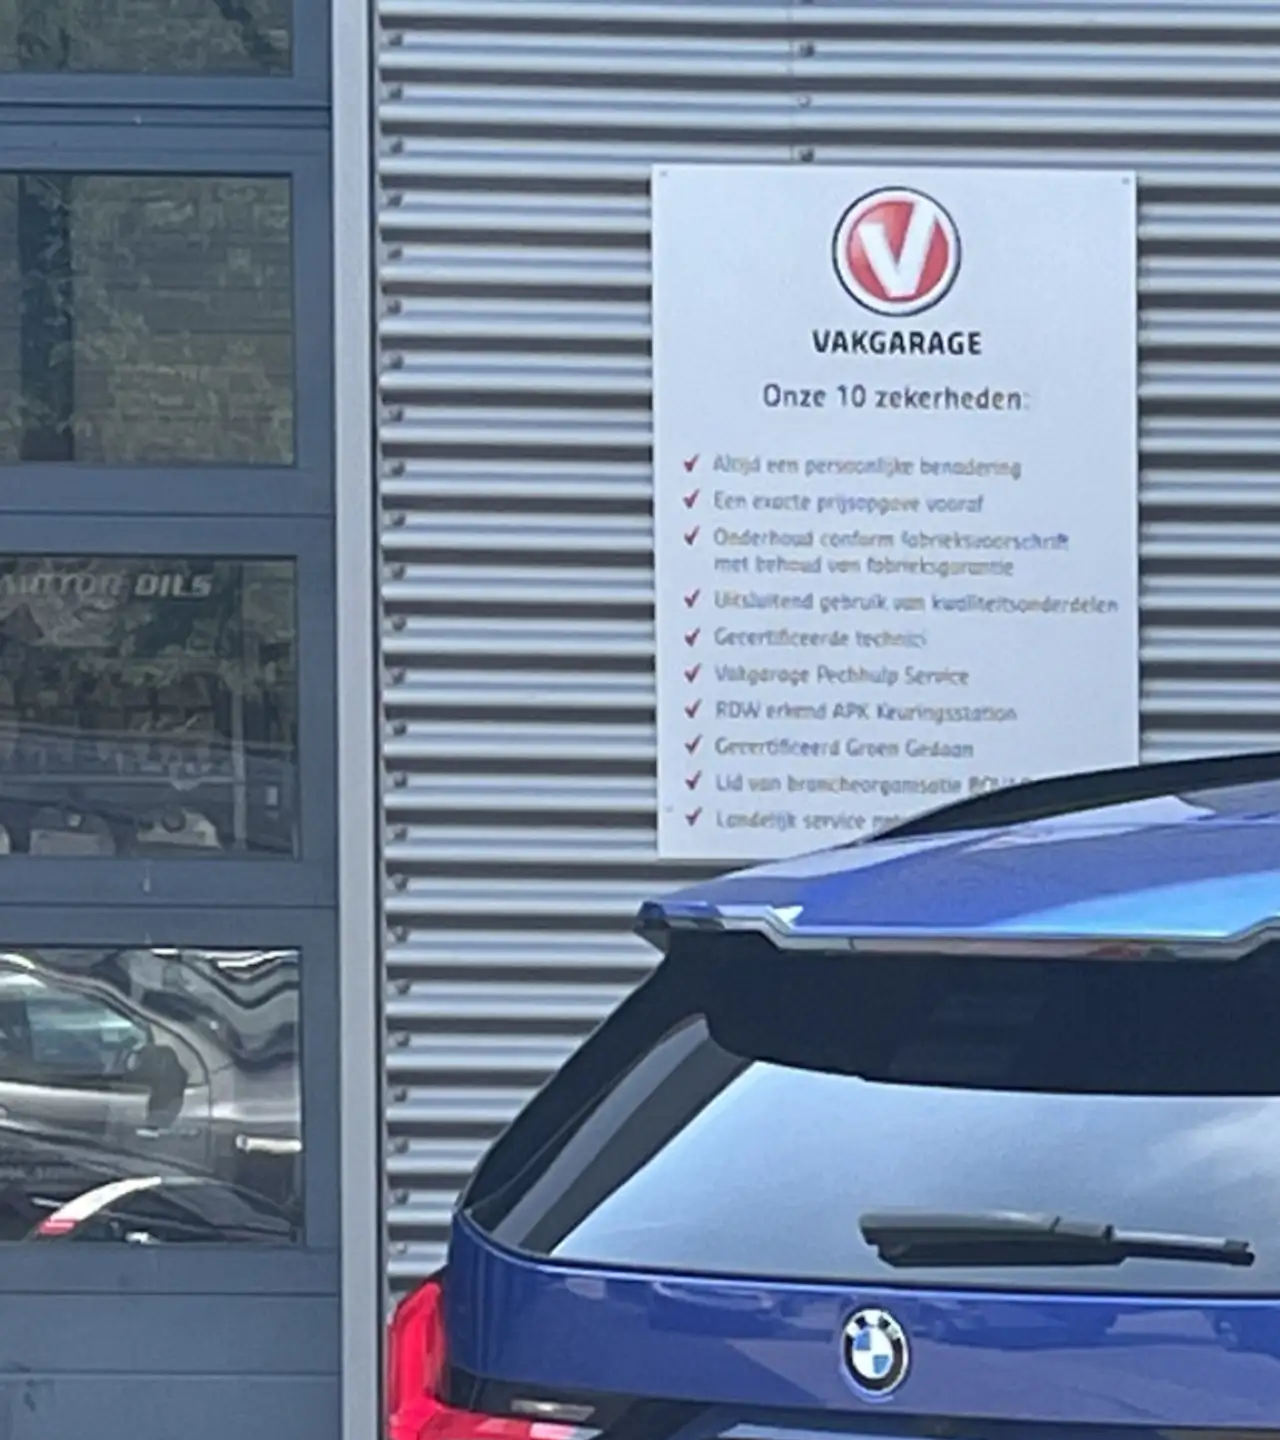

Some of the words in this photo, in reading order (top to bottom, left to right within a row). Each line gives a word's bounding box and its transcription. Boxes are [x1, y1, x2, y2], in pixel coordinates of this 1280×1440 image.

[812, 330, 982, 355] VAKGARAGE
[763, 383, 826, 408] Onze
[837, 384, 866, 408] 10
[875, 387, 1030, 411] zekerheden:
[713, 454, 761, 476] Altijd
[767, 458, 799, 474] een
[805, 457, 914, 478] persoonlijke
[920, 457, 1021, 480] benadering
[714, 490, 747, 510] Een
[752, 494, 811, 511] exacte
[817, 494, 920, 515] prijsopgave
[925, 494, 984, 513] vooraf
[713, 527, 813, 547] Onderhoud
[820, 530, 893, 548] conform
[714, 557, 748, 573] met
[756, 556, 822, 573] behoud
[828, 559, 861, 574] van
[868, 556, 1013, 578] fabrieksgarantie
[135, 572, 214, 597] OILS
[714, 590, 813, 609] Uitsluitend
[820, 593, 887, 613] gebruik
[892, 596, 925, 611] van
[714, 626, 849, 646] Gecertificeerde
[714, 664, 809, 687] Vakgarage
[816, 664, 899, 687] Pechhulp
[904, 665, 970, 686] Service
[715, 700, 761, 719] RDW
[766, 702, 827, 720] erkend
[832, 702, 870, 720] APK
[876, 703, 1017, 724] Keuringsstation
[714, 736, 840, 756] Gecertificeerd
[846, 737, 899, 757] Groen
[904, 738, 974, 758] Gedaan
[715, 773, 743, 792] Lid
[748, 777, 782, 793] van
[787, 774, 962, 796] brancheorganisatie
[716, 811, 797, 832] Landelijk
[802, 813, 866, 830] service
